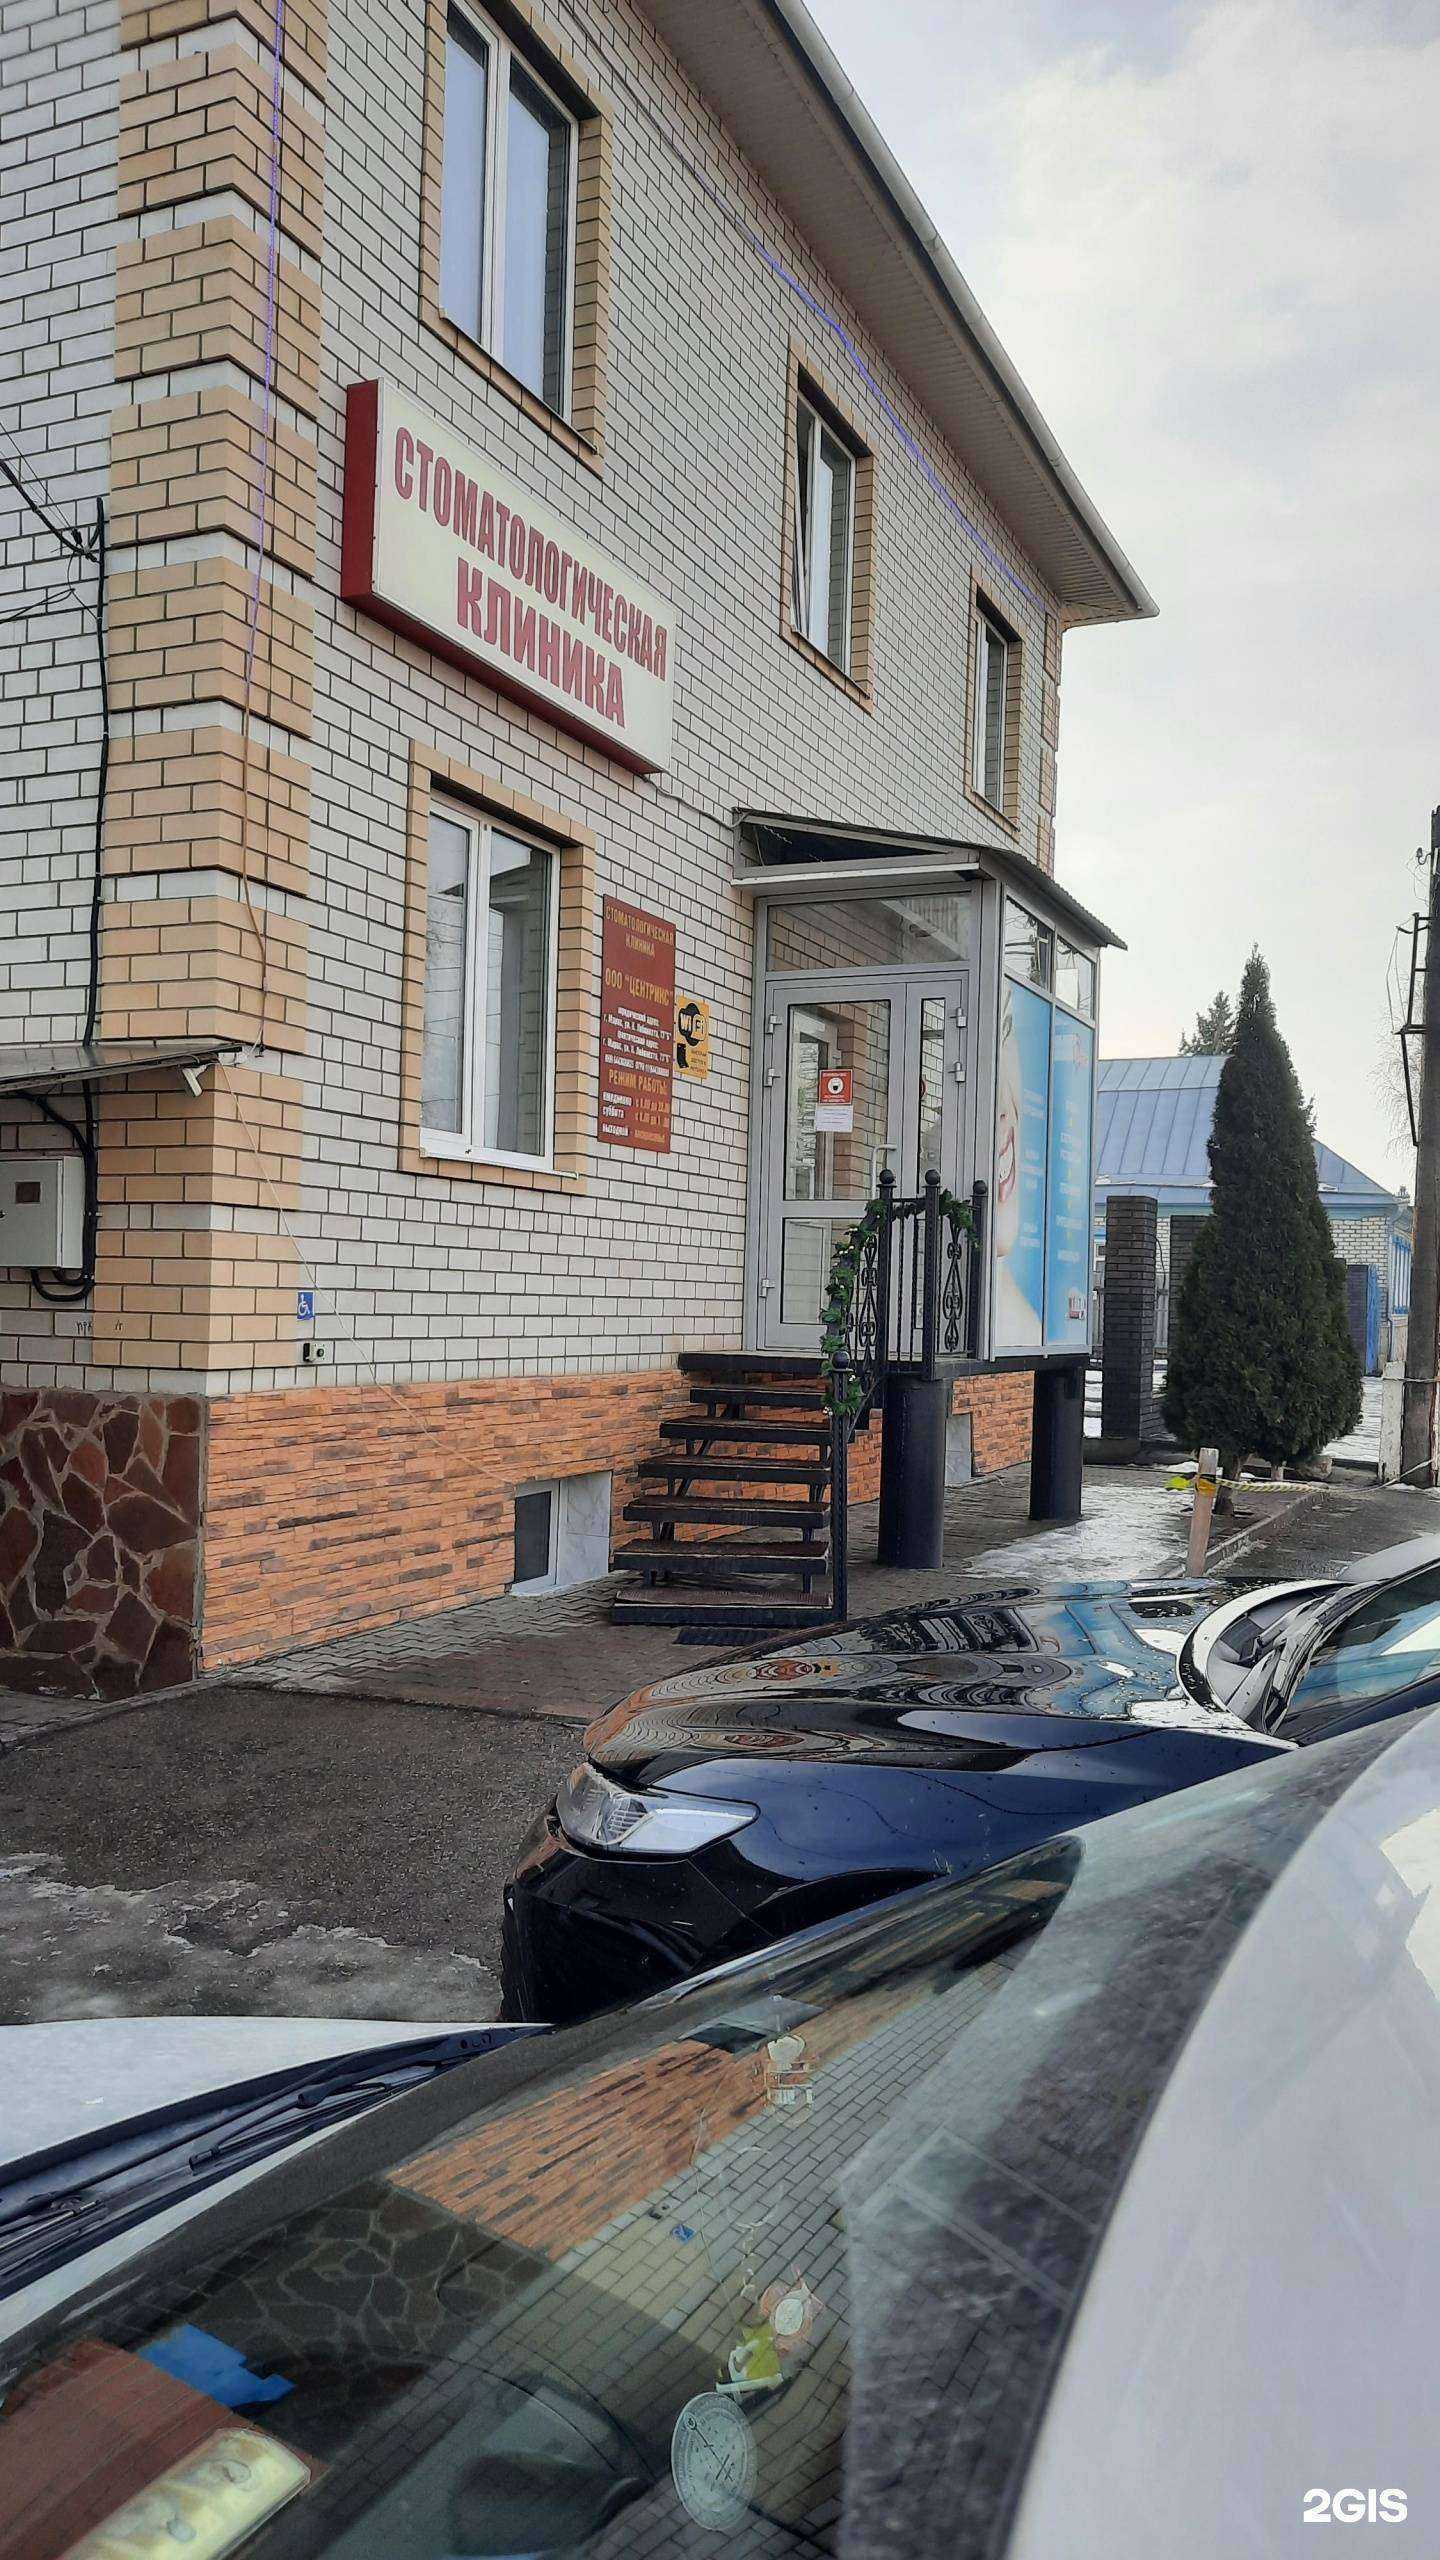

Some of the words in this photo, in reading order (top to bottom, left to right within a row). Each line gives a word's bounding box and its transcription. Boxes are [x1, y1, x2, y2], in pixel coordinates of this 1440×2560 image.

[394, 426, 668, 682] СТОМАТОЛОГИЧЕСКАЯ
[456, 555, 626, 730] КЛИНИКА
[605, 904, 674, 946] СТОМАТОЛОГИЧЕСКАЯ
[625, 931, 656, 958] КЛИНИКА
[605, 966, 623, 990] ООО
[608, 1068, 637, 1089] РЕЖИМ
